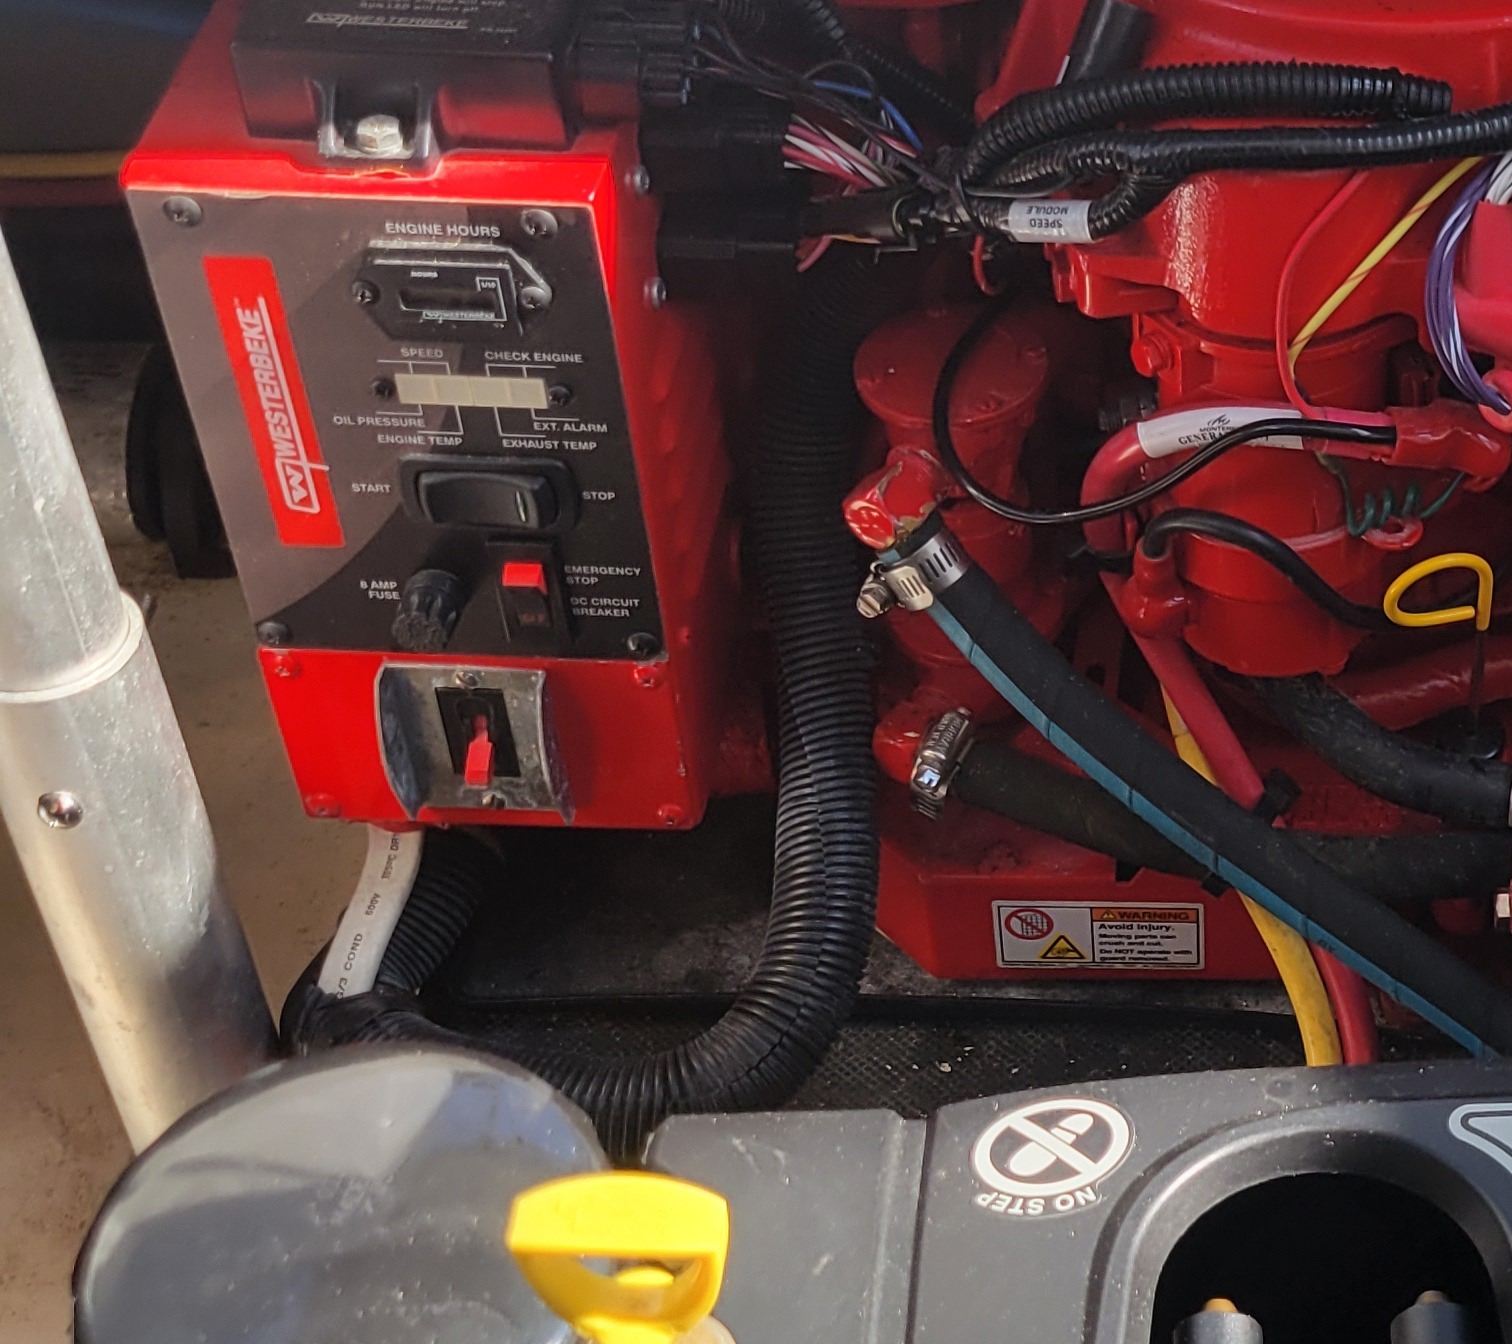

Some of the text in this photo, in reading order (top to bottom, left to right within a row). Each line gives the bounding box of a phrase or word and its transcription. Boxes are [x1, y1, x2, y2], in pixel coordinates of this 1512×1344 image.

[1025, 205, 1070, 216] MODULE
[1029, 217, 1064, 229] SPEED
[385, 222, 501, 238] ENGINE HOURS
[401, 347, 443, 358] SPEED
[484, 351, 584, 364] CHECK ENGINE
[234, 304, 300, 460] WESTERBEKE
[333, 416, 426, 428] OIL PRESSURE
[533, 422, 609, 433] EXT. ALARM
[377, 434, 464, 447] ENGINE TEMP
[502, 438, 598, 452] EXHAUST TEMP
[351, 482, 391, 494] START
[582, 490, 616, 502] STOP
[563, 565, 642, 577] EMERGENCY
[371, 580, 398, 591] AMP
[566, 576, 600, 586] STOP
[368, 590, 401, 601] FUSE
[570, 597, 641, 609] DC CIRCUIT
[572, 607, 631, 618] BREAKER
[1118, 910, 1190, 921] WARNING
[342, 891, 381, 971] COND 600V
[1099, 922, 1135, 931] Avoid
[975, 1185, 1098, 1217] NO STEP
